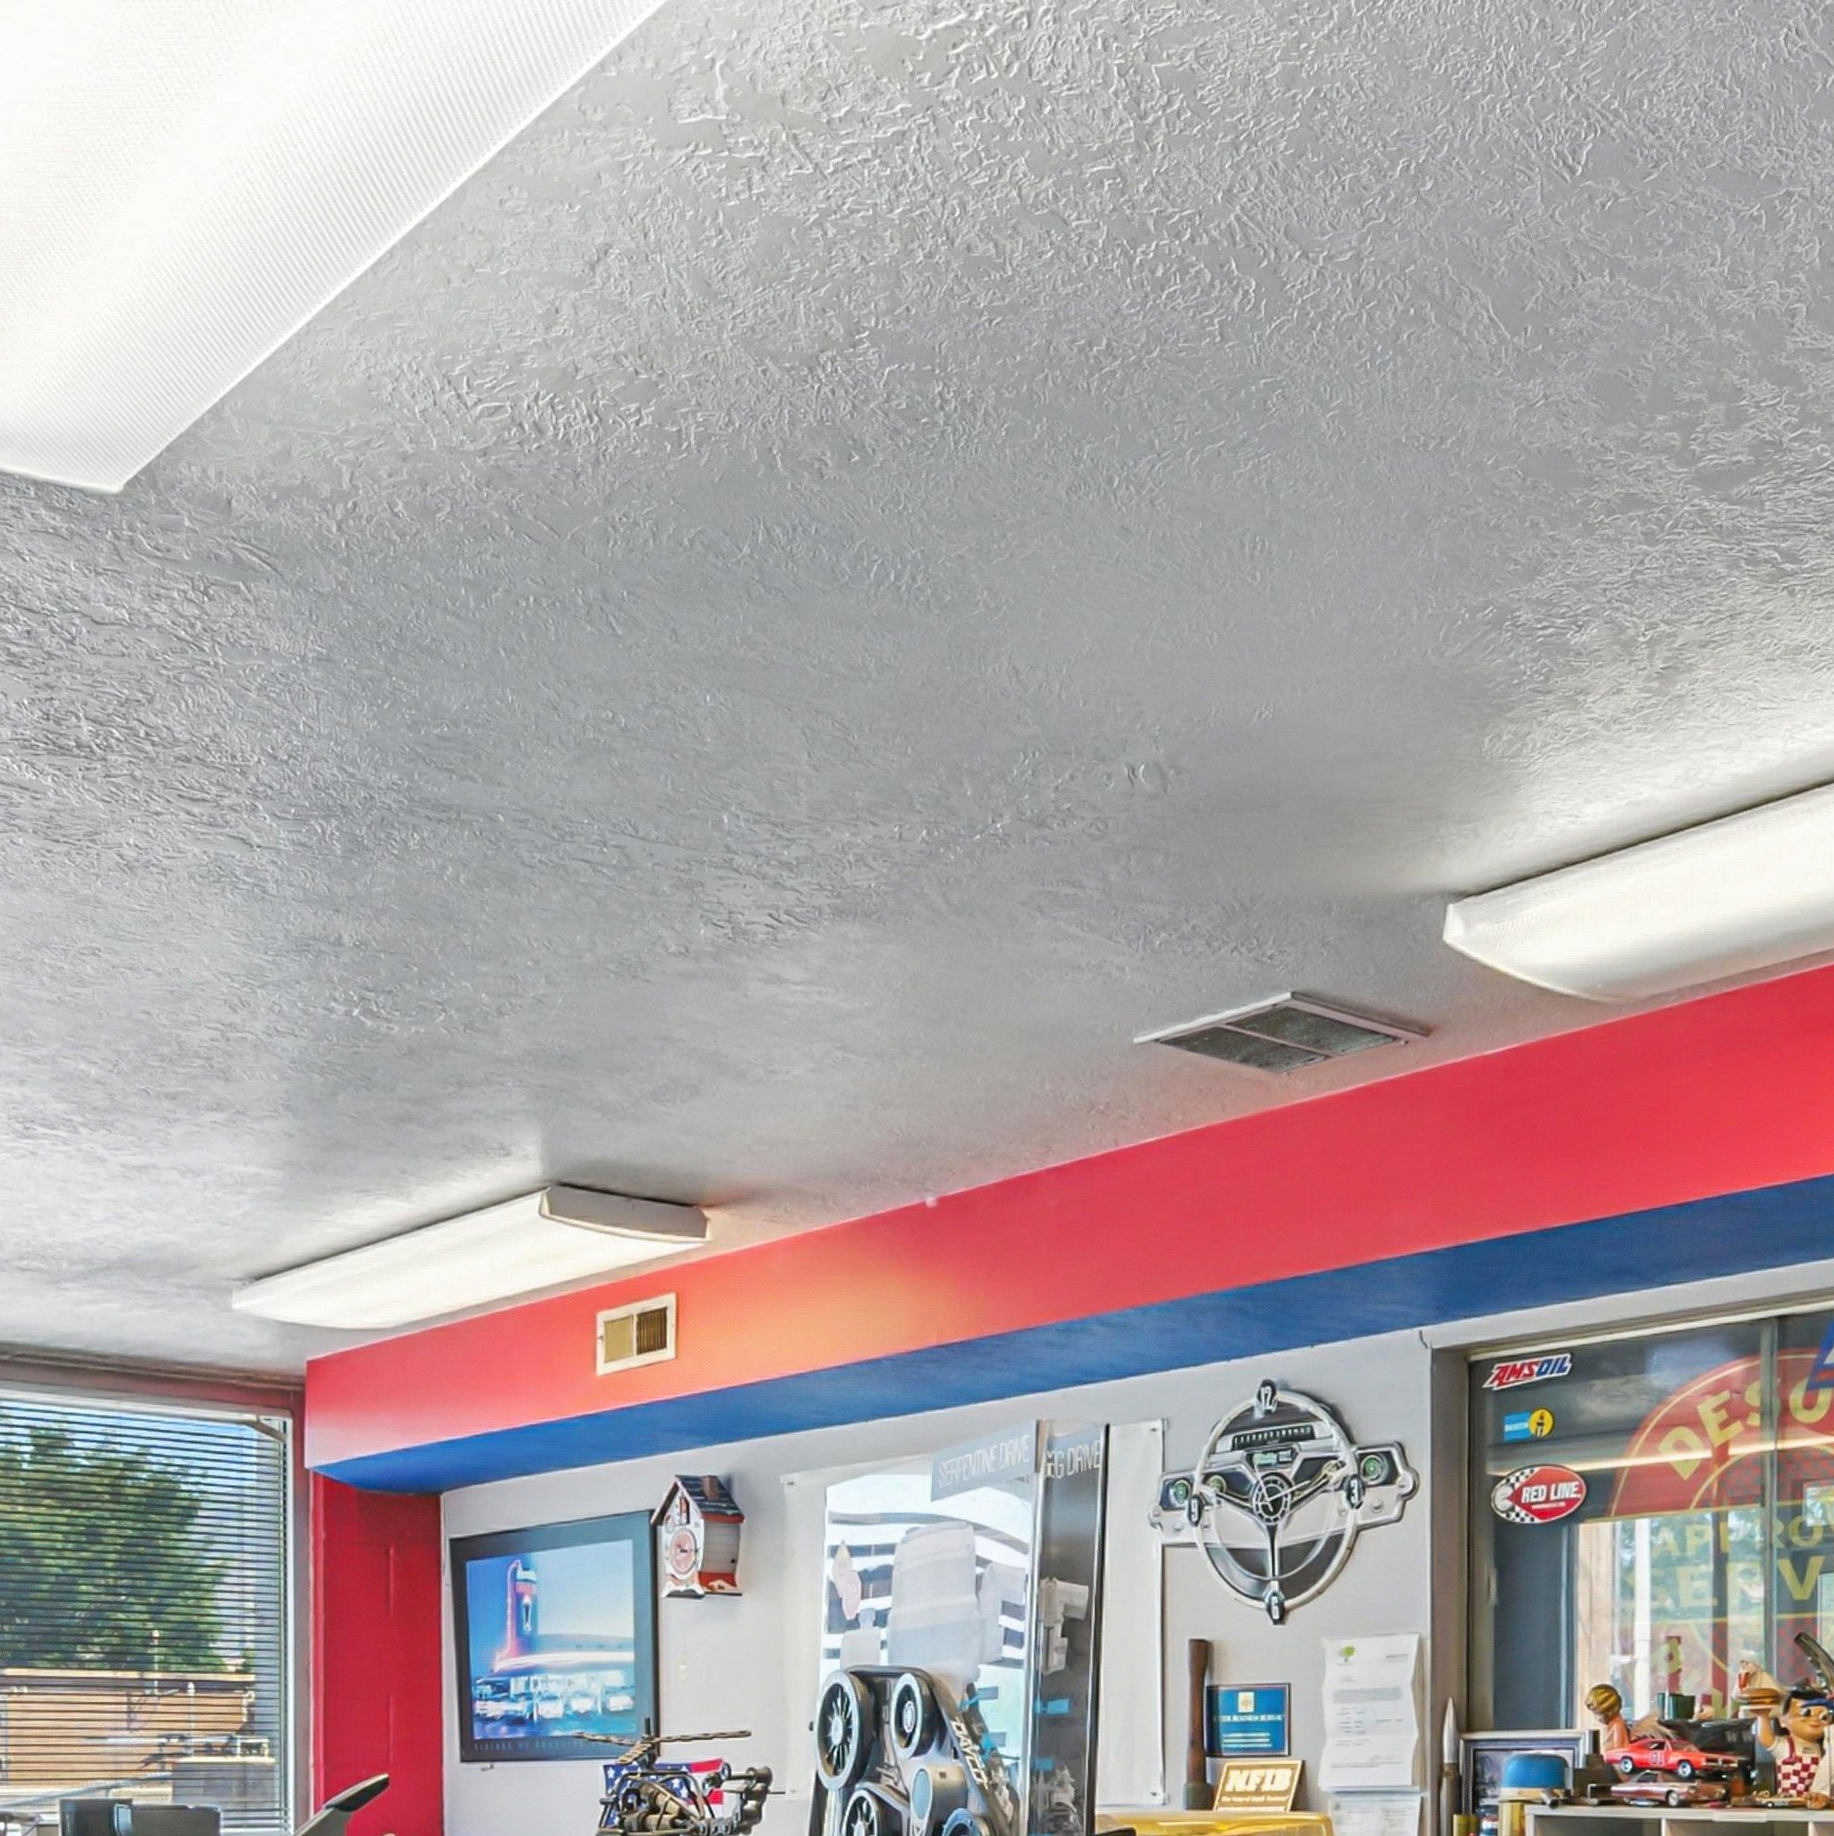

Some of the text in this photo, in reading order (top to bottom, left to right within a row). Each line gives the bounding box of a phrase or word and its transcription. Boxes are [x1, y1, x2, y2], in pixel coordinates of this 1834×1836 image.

[1488, 1356, 1571, 1387] AMSOIL
[999, 1433, 1031, 1471] DRIVE
[1521, 1484, 1547, 1503] RED
